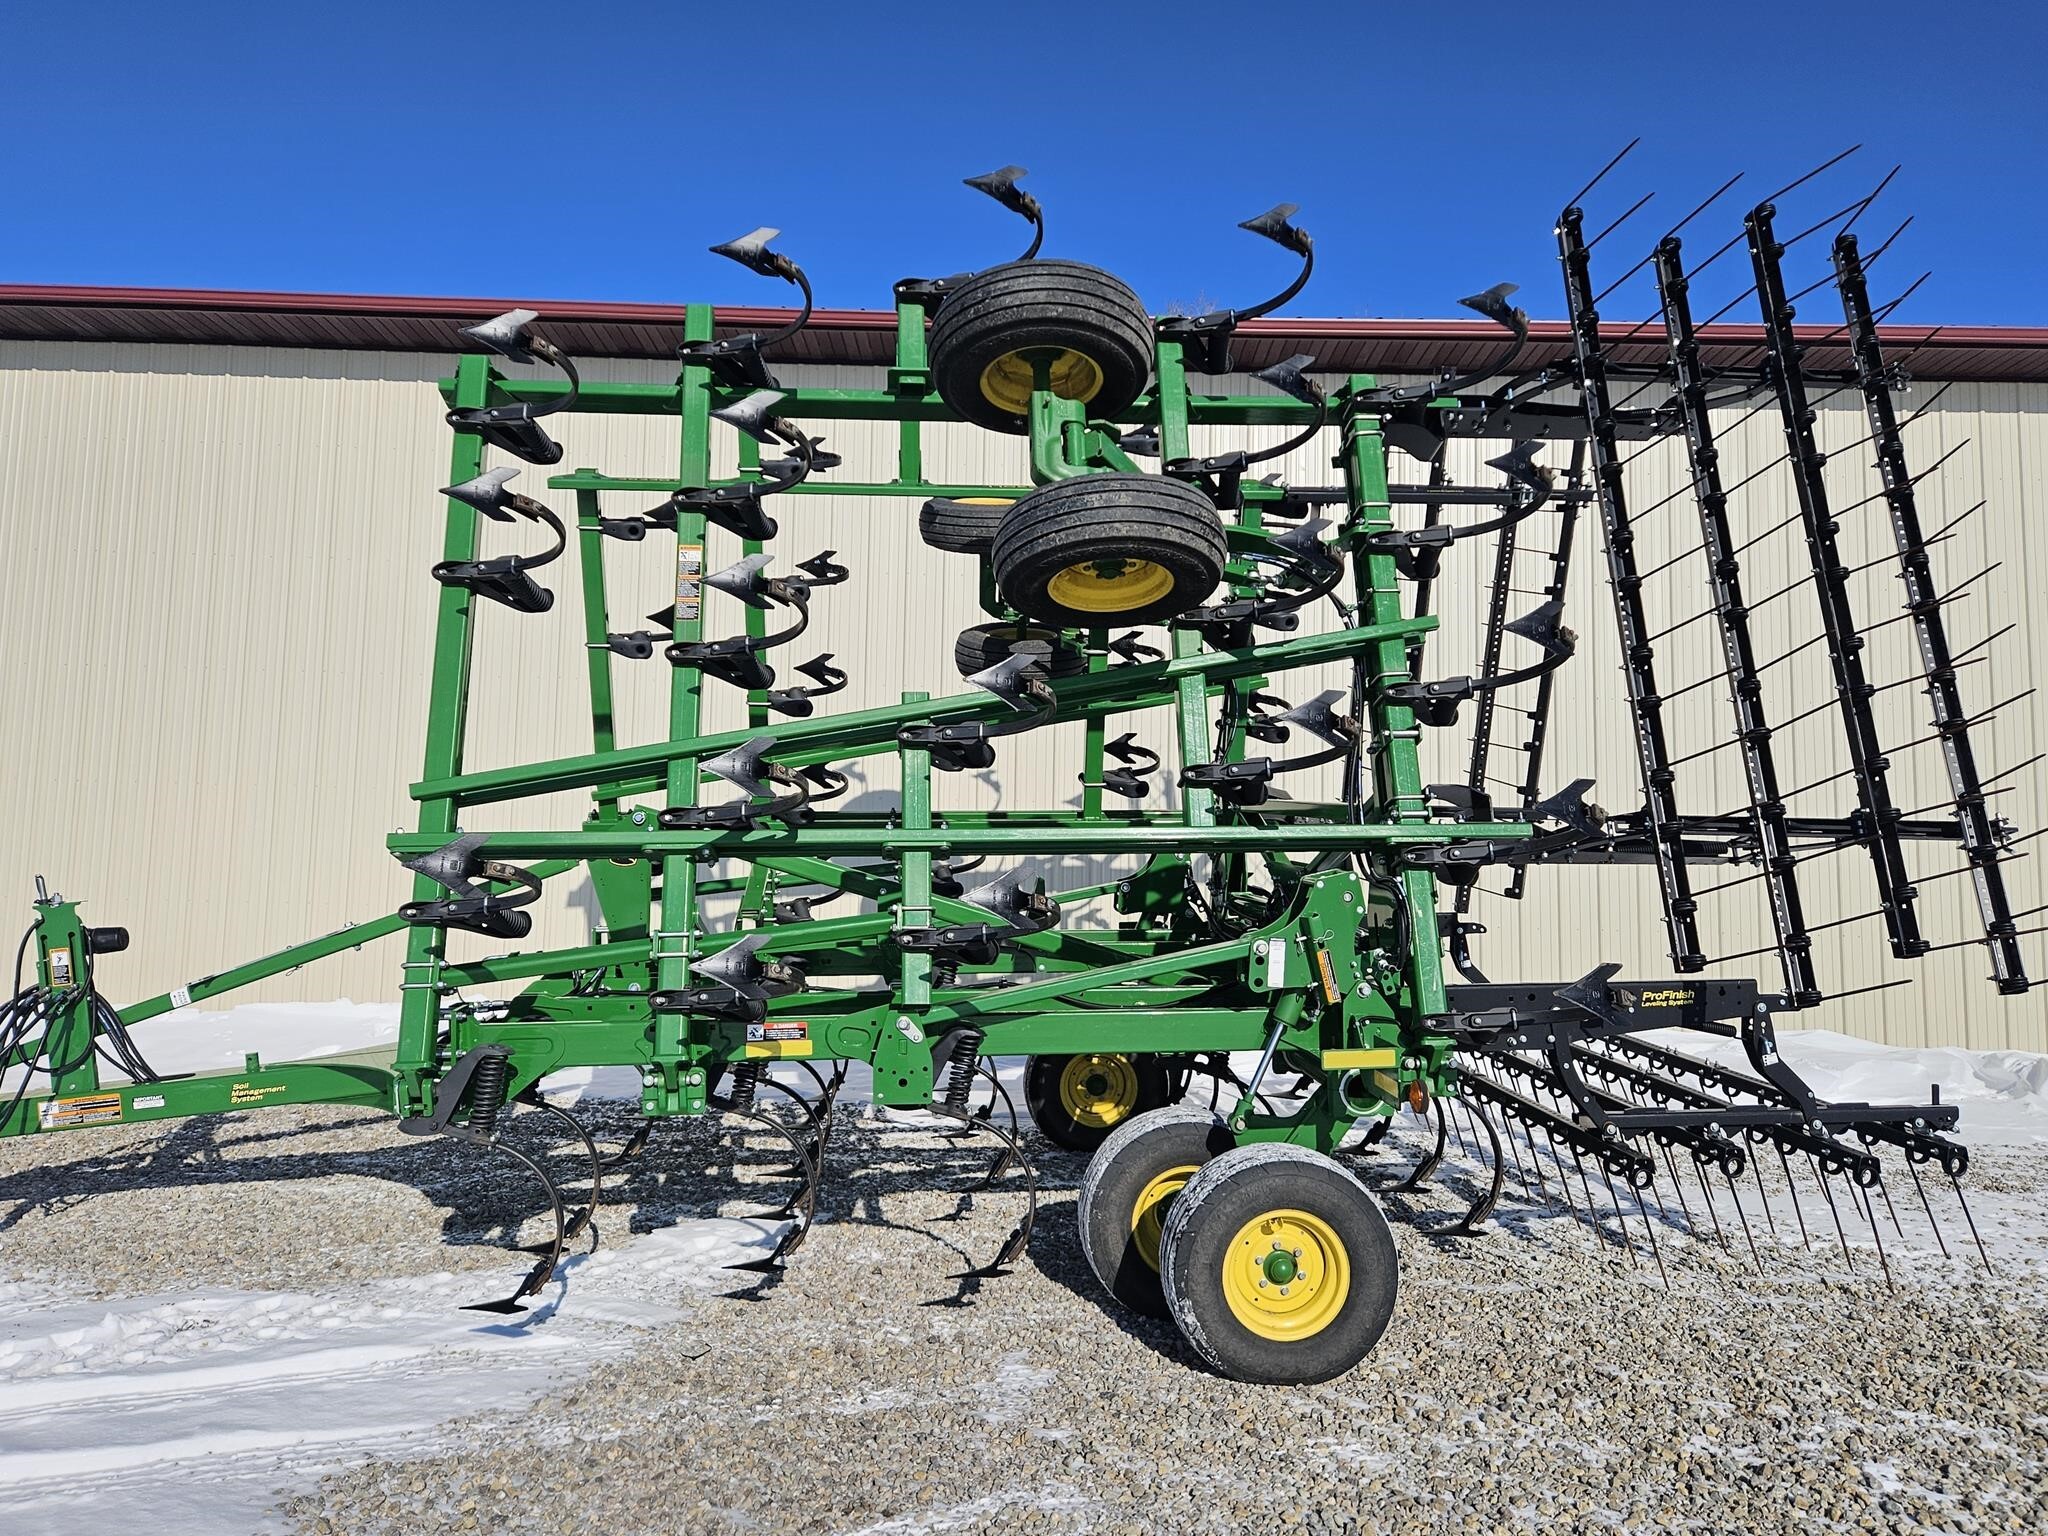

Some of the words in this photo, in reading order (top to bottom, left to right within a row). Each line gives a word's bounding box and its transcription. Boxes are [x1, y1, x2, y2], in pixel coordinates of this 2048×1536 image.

[1642, 990, 1695, 1001] ProFinish
[231, 1085, 286, 1097] Management
[232, 1082, 249, 1090] Soil
[230, 1095, 263, 1104] System
